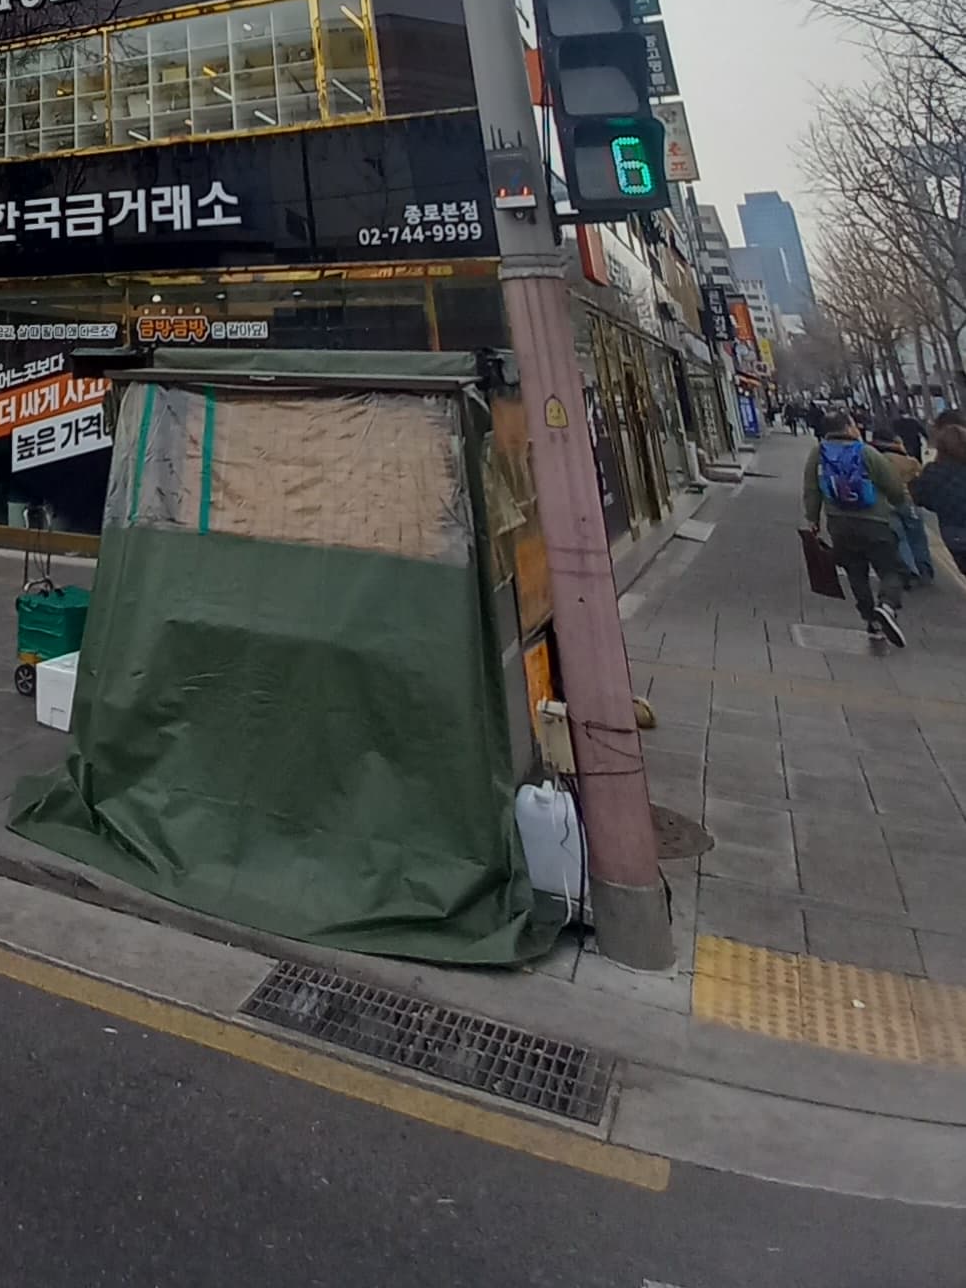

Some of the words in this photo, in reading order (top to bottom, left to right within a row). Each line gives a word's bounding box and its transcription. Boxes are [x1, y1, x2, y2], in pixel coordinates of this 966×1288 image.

[610, 136, 652, 194] 6
[404, 200, 479, 225] 종로본점
[358, 223, 482, 246] 02-744-9999
[19, 381, 60, 419] 싸게
[17, 425, 56, 461] 높은
